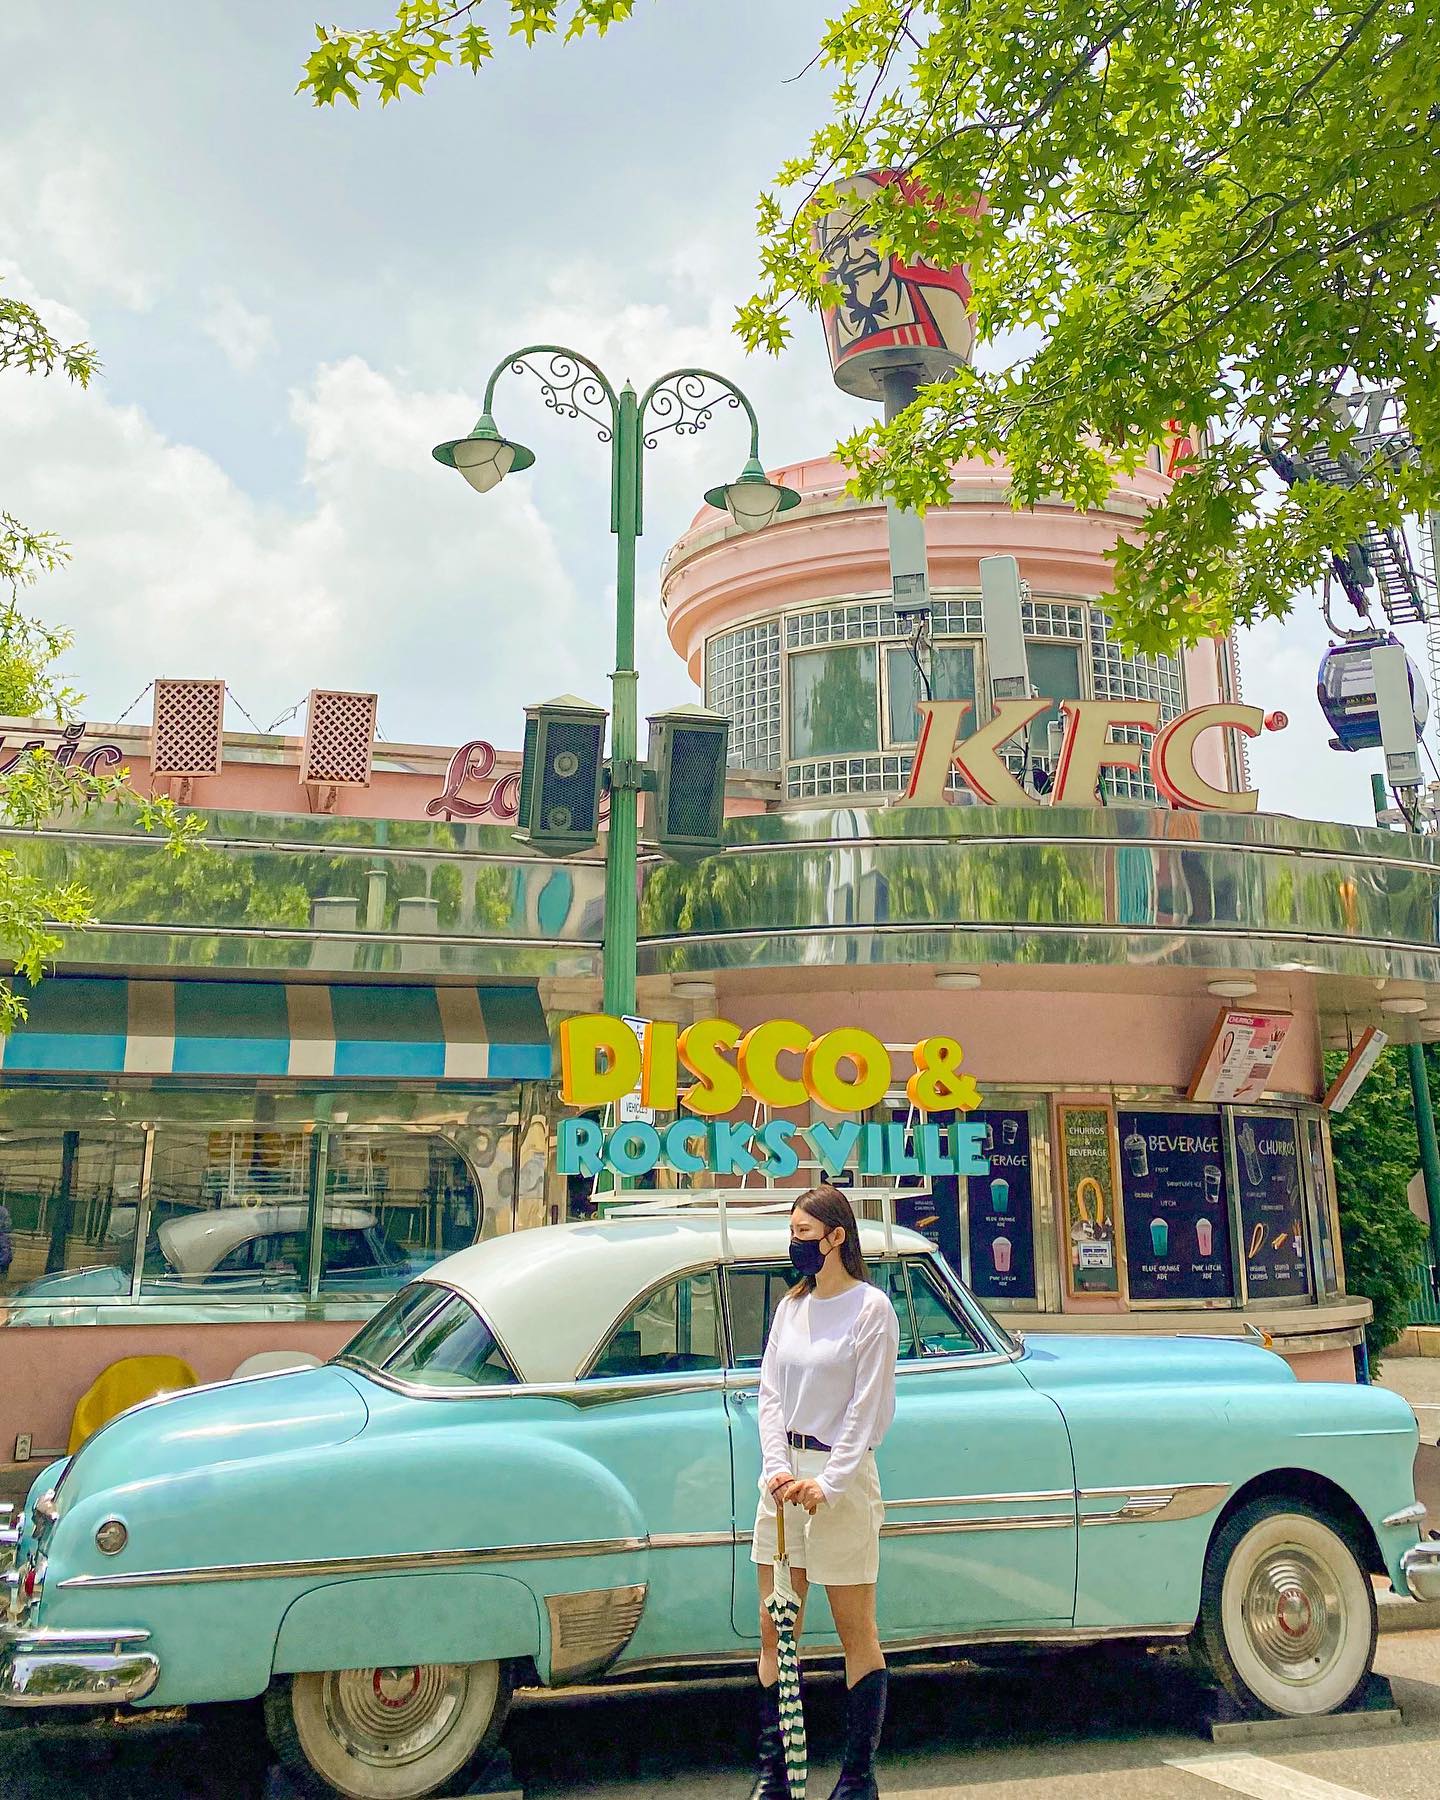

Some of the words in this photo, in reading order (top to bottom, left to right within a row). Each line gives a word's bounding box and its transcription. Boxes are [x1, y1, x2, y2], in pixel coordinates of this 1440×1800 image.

[891, 698, 1265, 815] KFC
[560, 1014, 892, 1115] DISCO
[907, 1035, 984, 1112] &
[1069, 1127, 1105, 1135] CHURROS
[1148, 1135, 1219, 1153] BEVERAGE
[1258, 1140, 1296, 1156] CHURROS
[1069, 1149, 1107, 1157] BEVERAGE
[1142, 1264, 1158, 1272] BLUE
[1159, 1264, 1180, 1272] ORANGE
[1156, 1273, 1168, 1281] ADE
[1202, 1272, 1213, 1280] ADE
